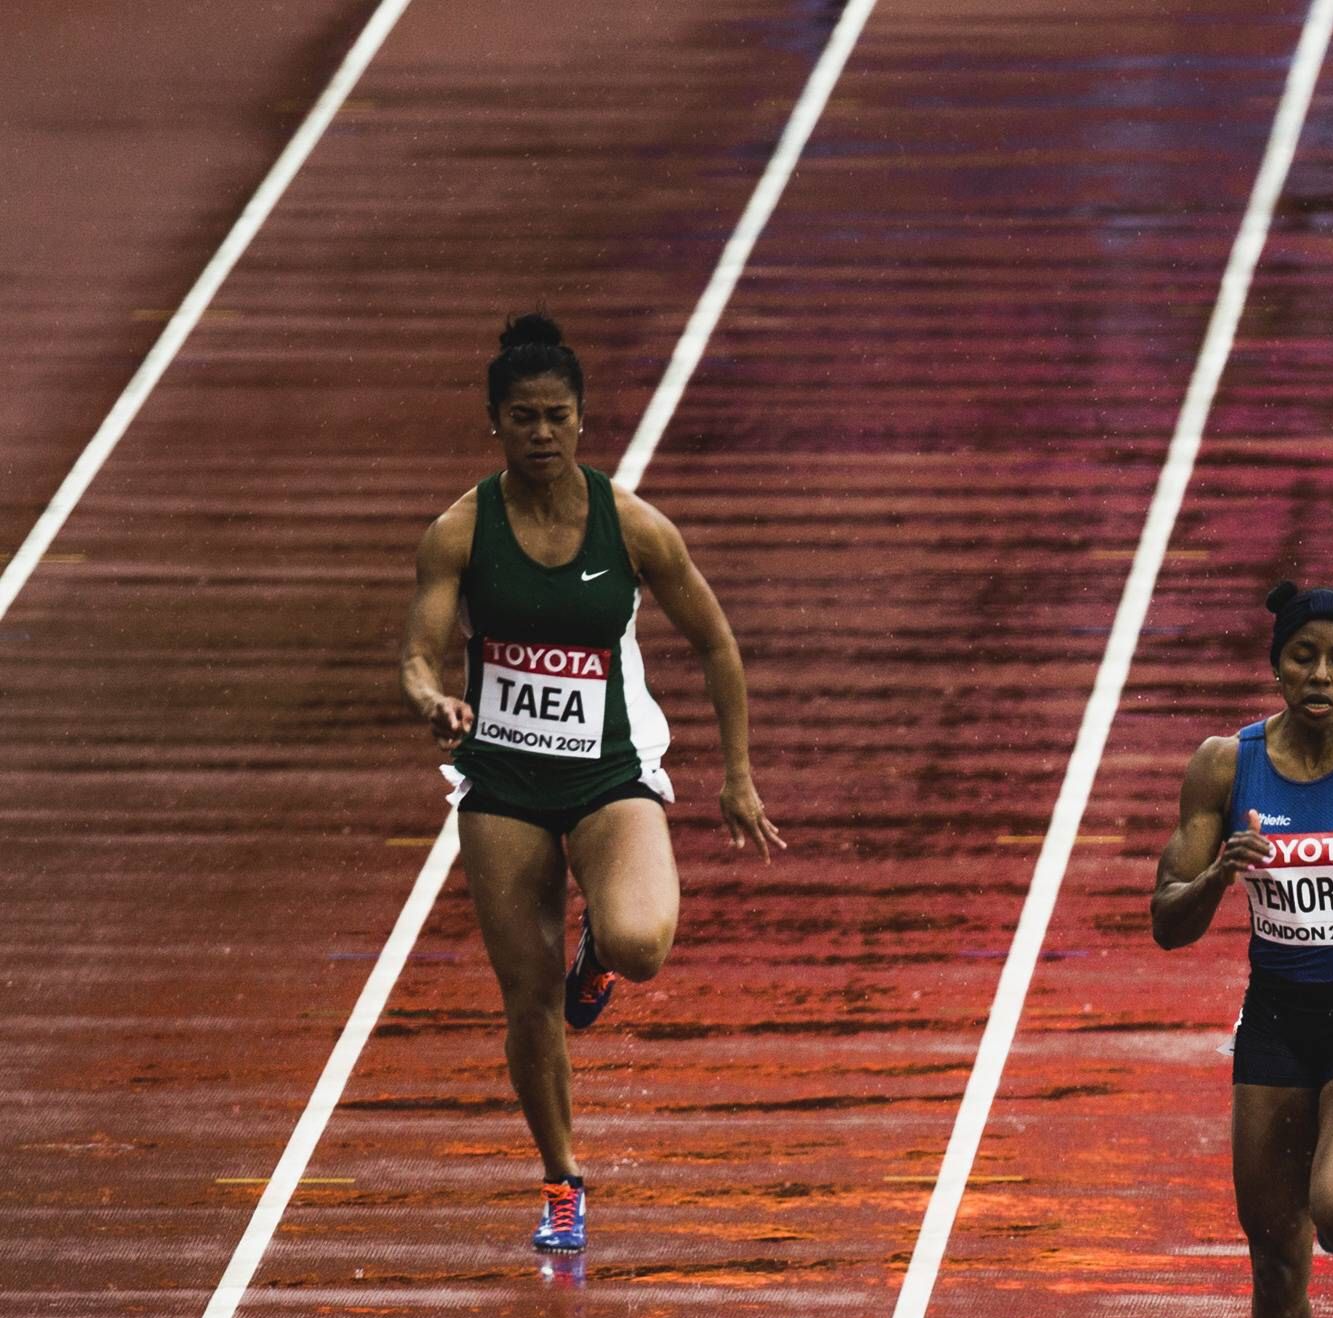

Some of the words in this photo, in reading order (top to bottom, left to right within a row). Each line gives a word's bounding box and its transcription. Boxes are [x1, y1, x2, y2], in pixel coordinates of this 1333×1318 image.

[486, 642, 603, 676] TOYOTA
[497, 677, 585, 724] TAEA
[480, 721, 553, 750] LONDON
[556, 736, 596, 753] 2017
[1258, 813, 1291, 826] hletic
[1256, 916, 1326, 941] LONDON
